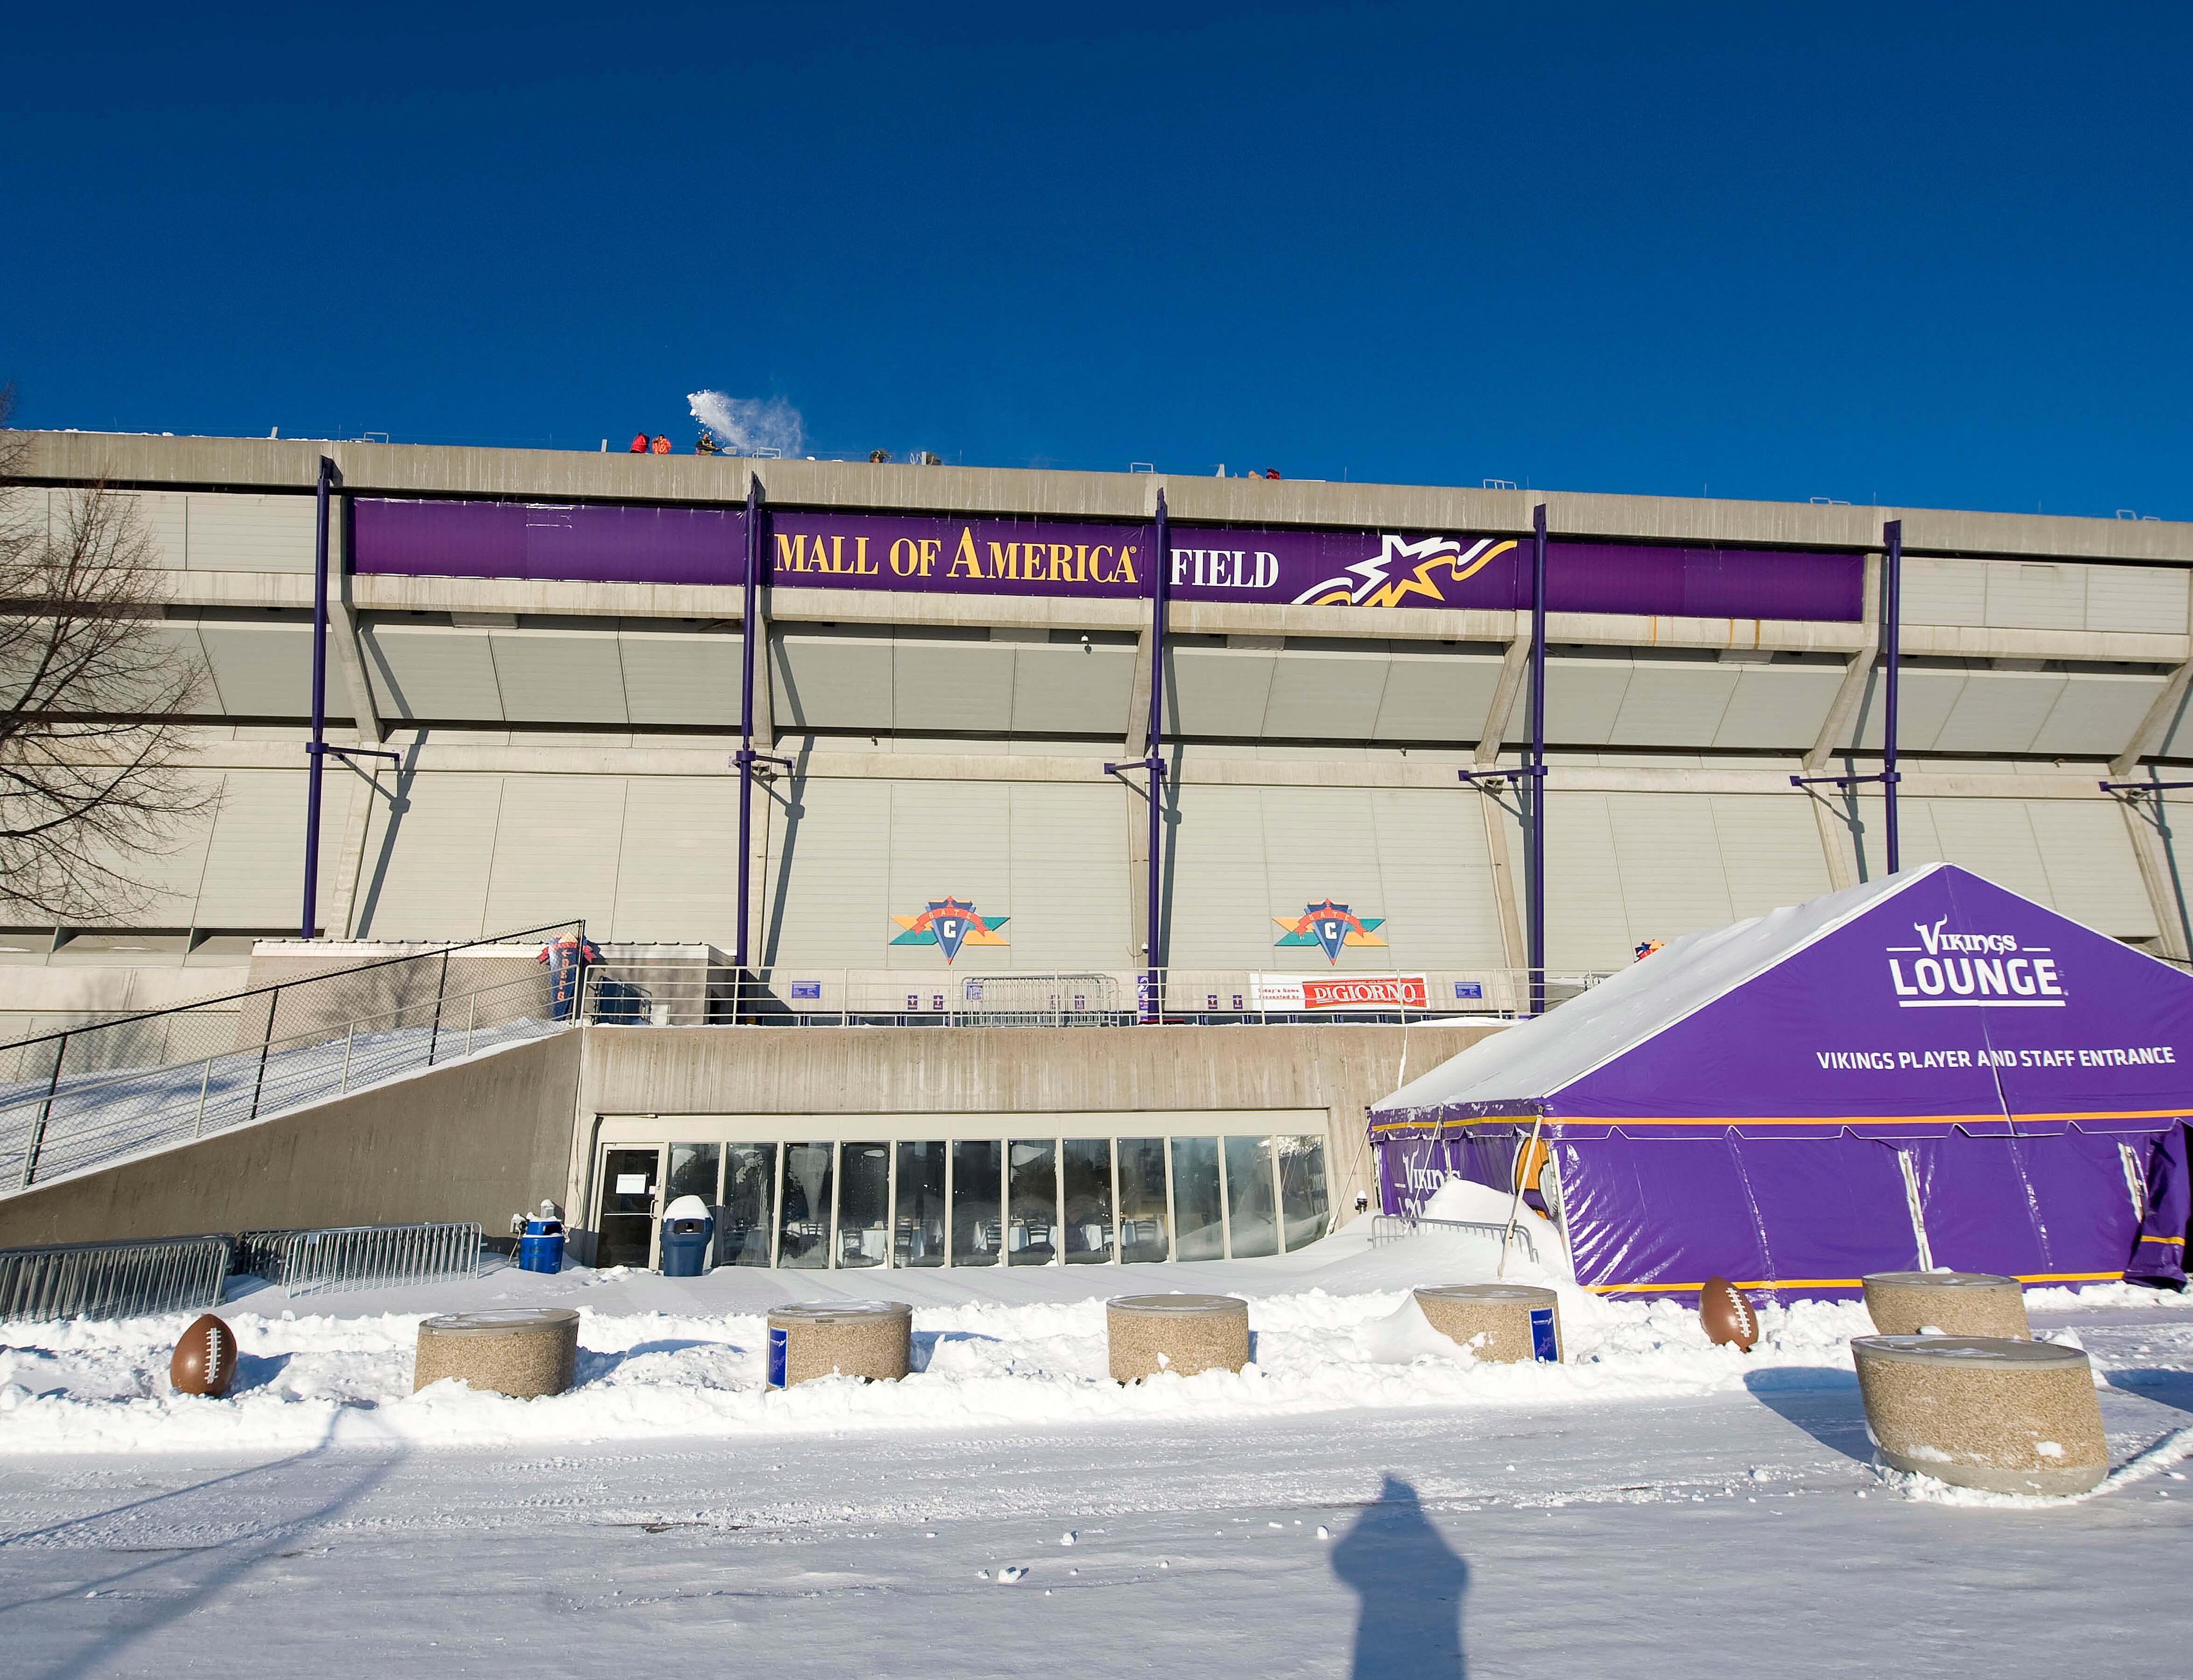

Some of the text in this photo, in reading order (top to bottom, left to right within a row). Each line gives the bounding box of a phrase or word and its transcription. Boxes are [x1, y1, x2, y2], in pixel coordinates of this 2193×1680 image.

[774, 533, 879, 575] MALL
[890, 539, 941, 577] OF
[1170, 549, 1279, 588] FIELD
[943, 920, 956, 938] C
[1324, 922, 1337, 939] C
[1889, 959, 2063, 995] LOUNGE
[1817, 1047, 2176, 1070] VIKINGS PLAYER AND STAFF ENTRANCE
